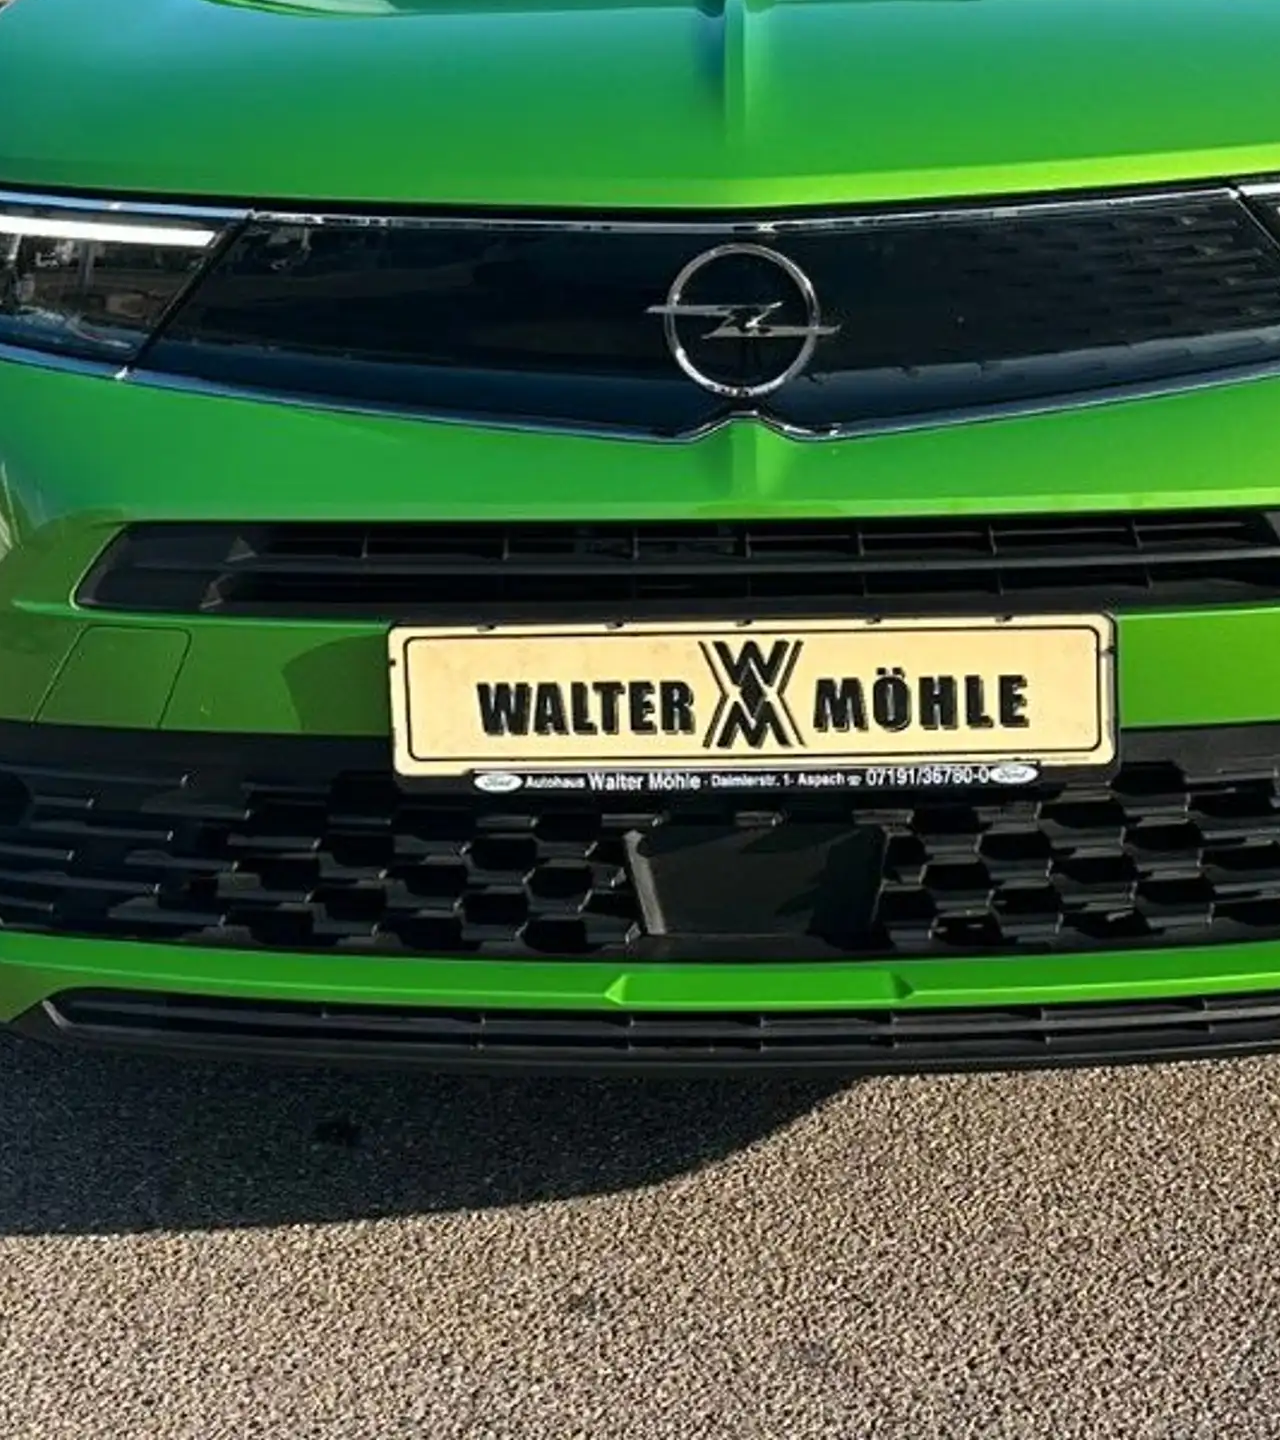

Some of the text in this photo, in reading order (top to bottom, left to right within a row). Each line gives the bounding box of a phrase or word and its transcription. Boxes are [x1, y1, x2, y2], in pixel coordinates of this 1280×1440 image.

[476, 679, 695, 735] WALTER
[813, 666, 1031, 732] MÖHLE
[525, 776, 585, 788] Autohaus
[588, 772, 643, 790] Walter
[649, 769, 701, 790] Möhle
